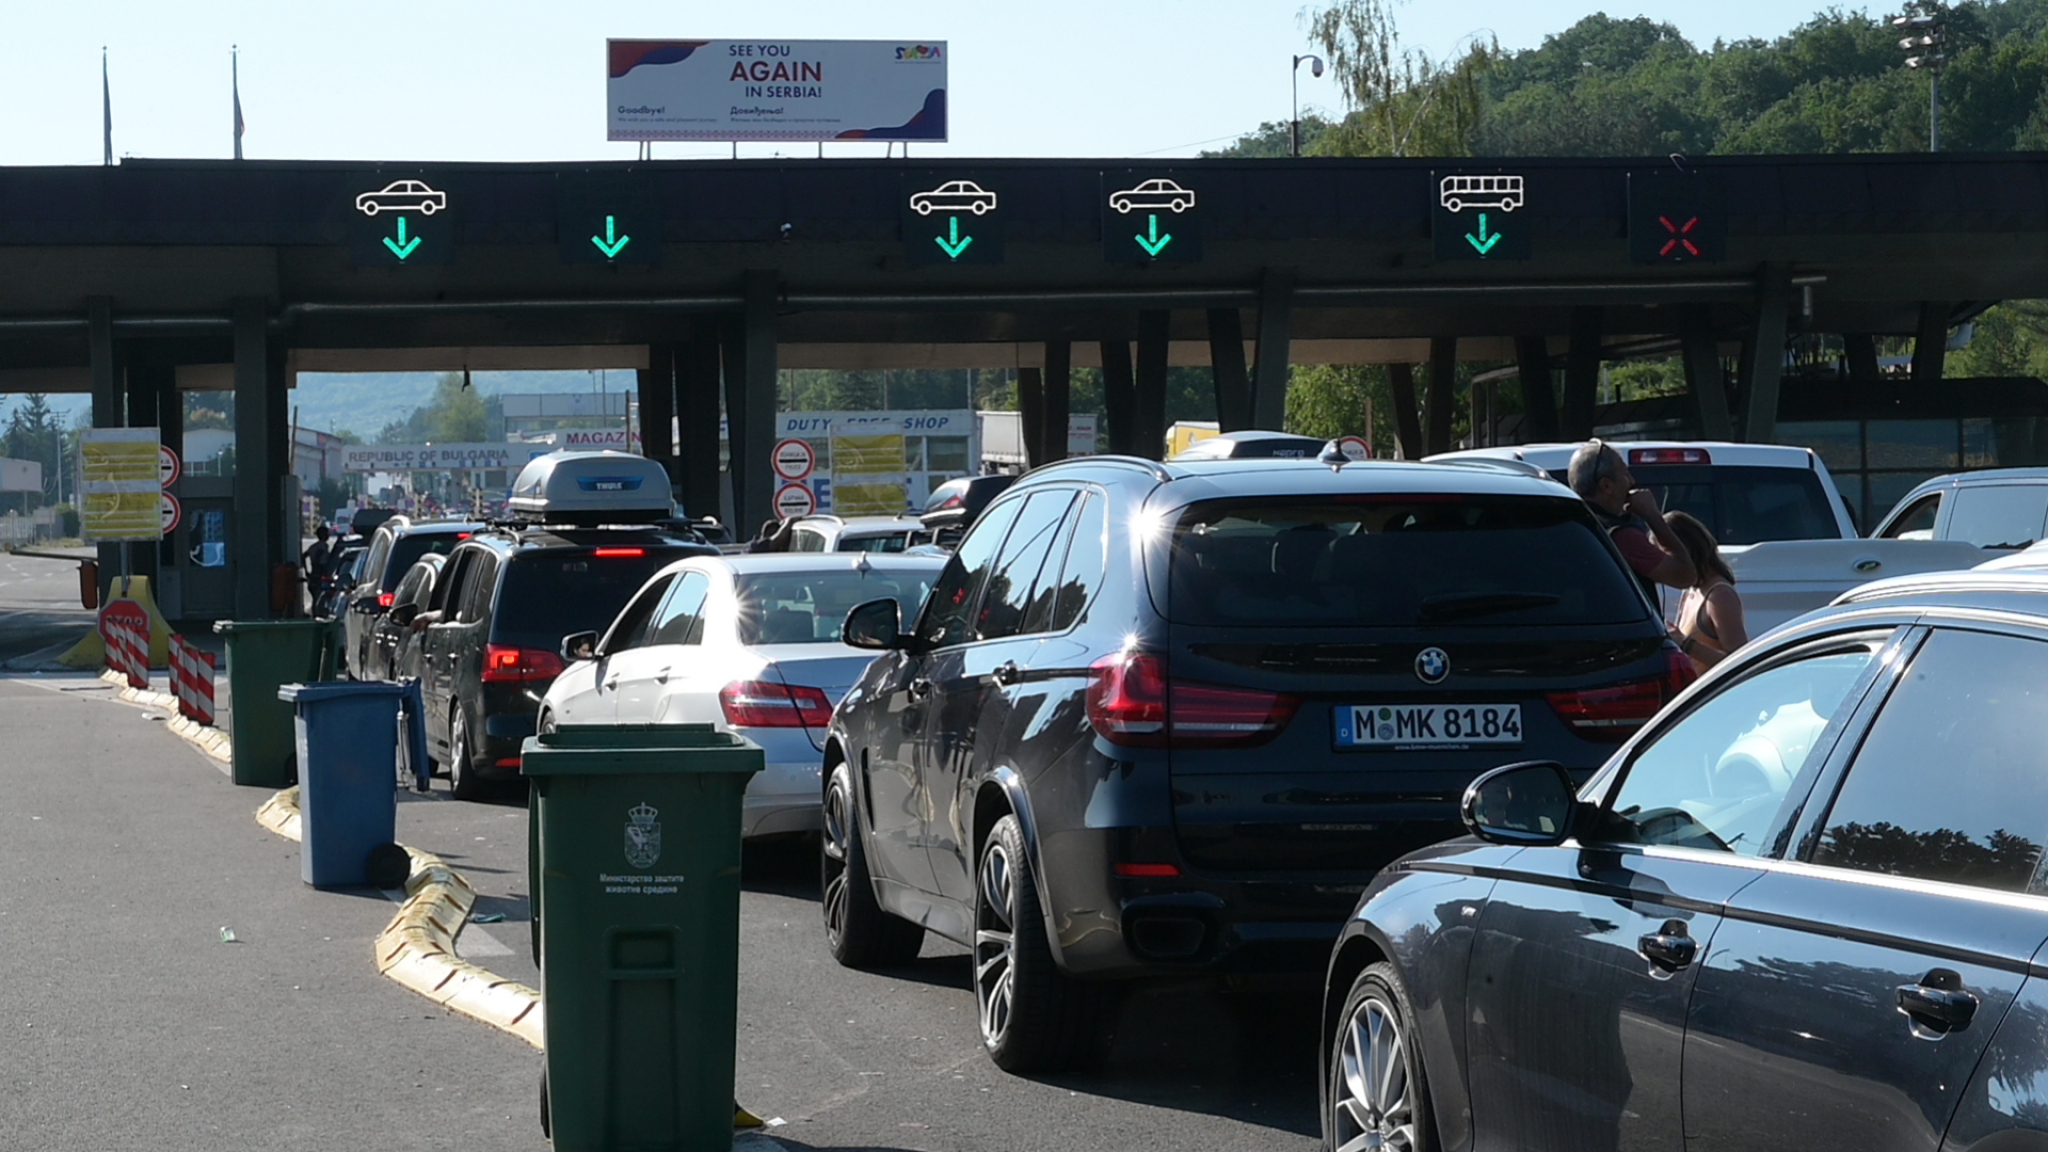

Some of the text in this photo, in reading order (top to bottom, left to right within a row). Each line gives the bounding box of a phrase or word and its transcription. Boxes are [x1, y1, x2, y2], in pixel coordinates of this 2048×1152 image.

[729, 45, 790, 57] SEE YOU
[729, 61, 822, 82] AGAIN
[745, 86, 822, 98] IN SERBIA!
[617, 106, 665, 116] Goodbye!
[787, 419, 832, 431] DUTY
[904, 417, 949, 429] SHOP
[567, 432, 643, 444] MAGAZN
[350, 450, 509, 462] REPUBLIC OF BULGARIA
[596, 482, 622, 490] THULE
[1341, 708, 1520, 739] D M MK 8184
[599, 873, 684, 884] Министарство заштите
[605, 885, 678, 895] животне средине
